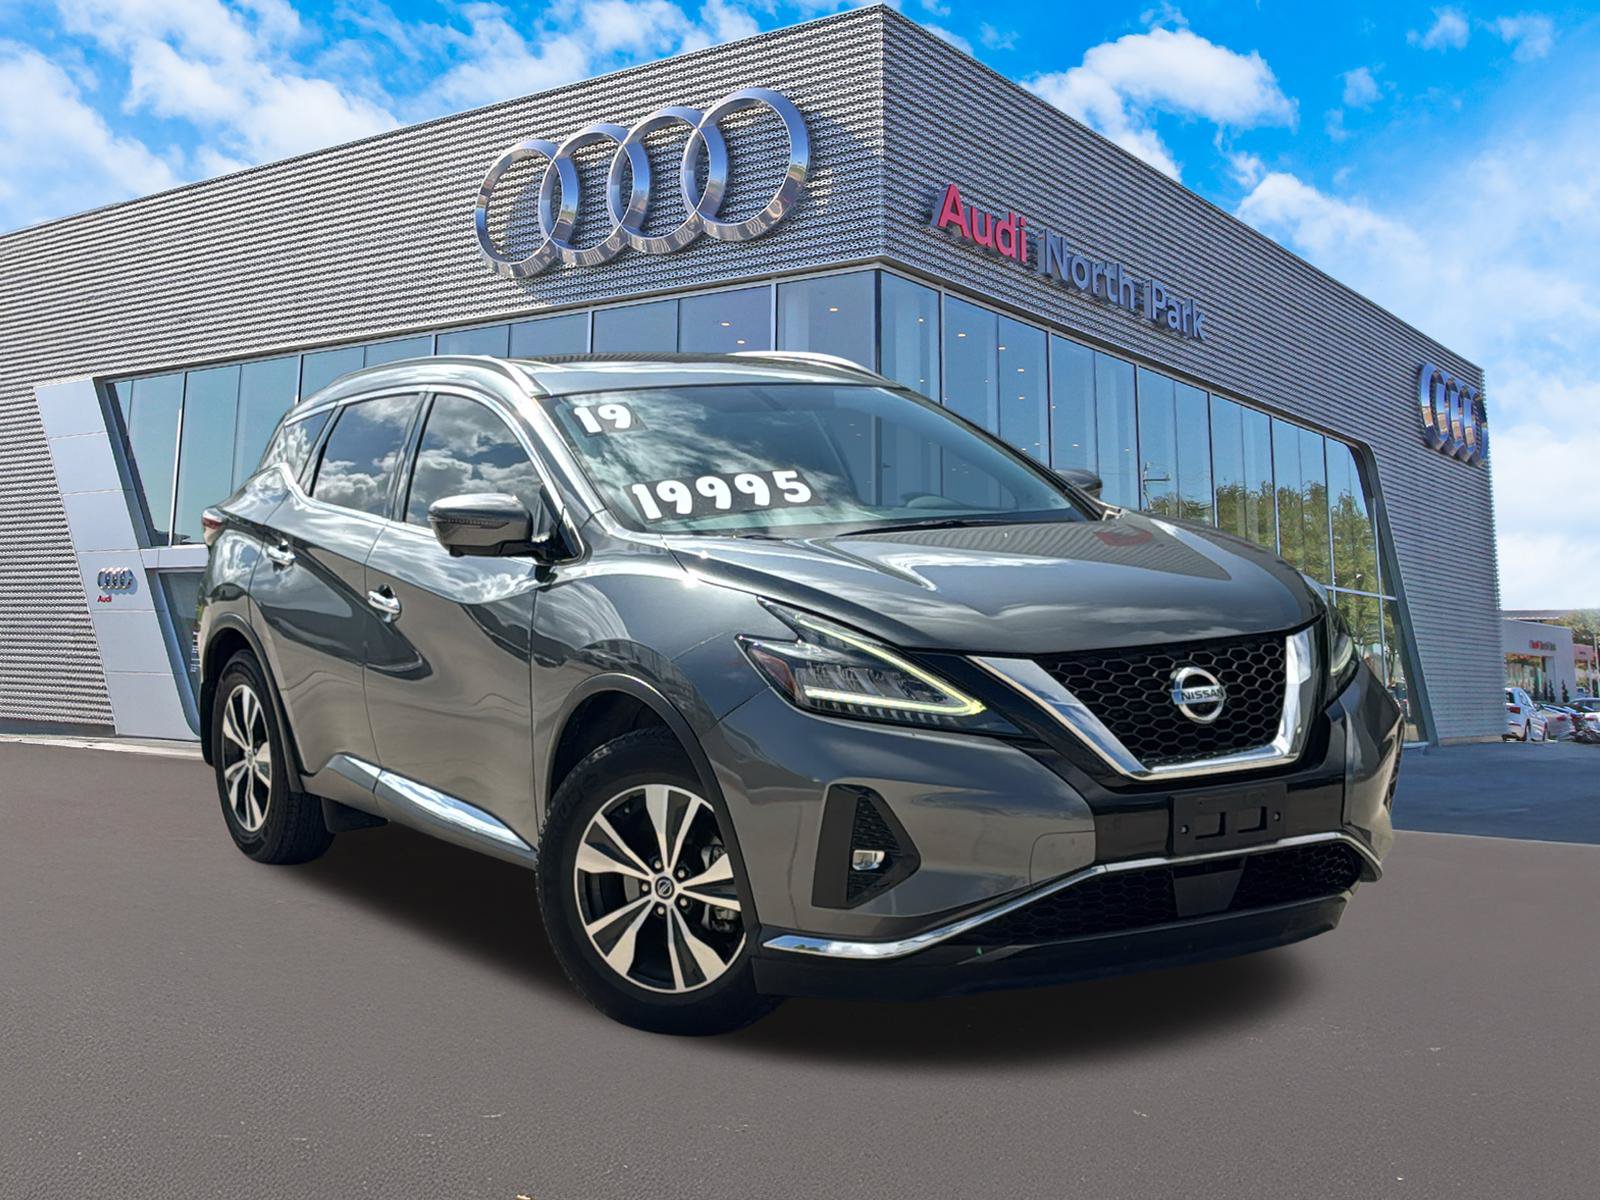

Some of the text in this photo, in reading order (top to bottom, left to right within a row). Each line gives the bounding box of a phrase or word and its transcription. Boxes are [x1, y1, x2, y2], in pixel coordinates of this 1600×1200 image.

[936, 183, 1206, 341] Audi North Park
[574, 403, 632, 433] 19
[632, 470, 812, 520] 19995
[1182, 688, 1224, 701] NISSAN
